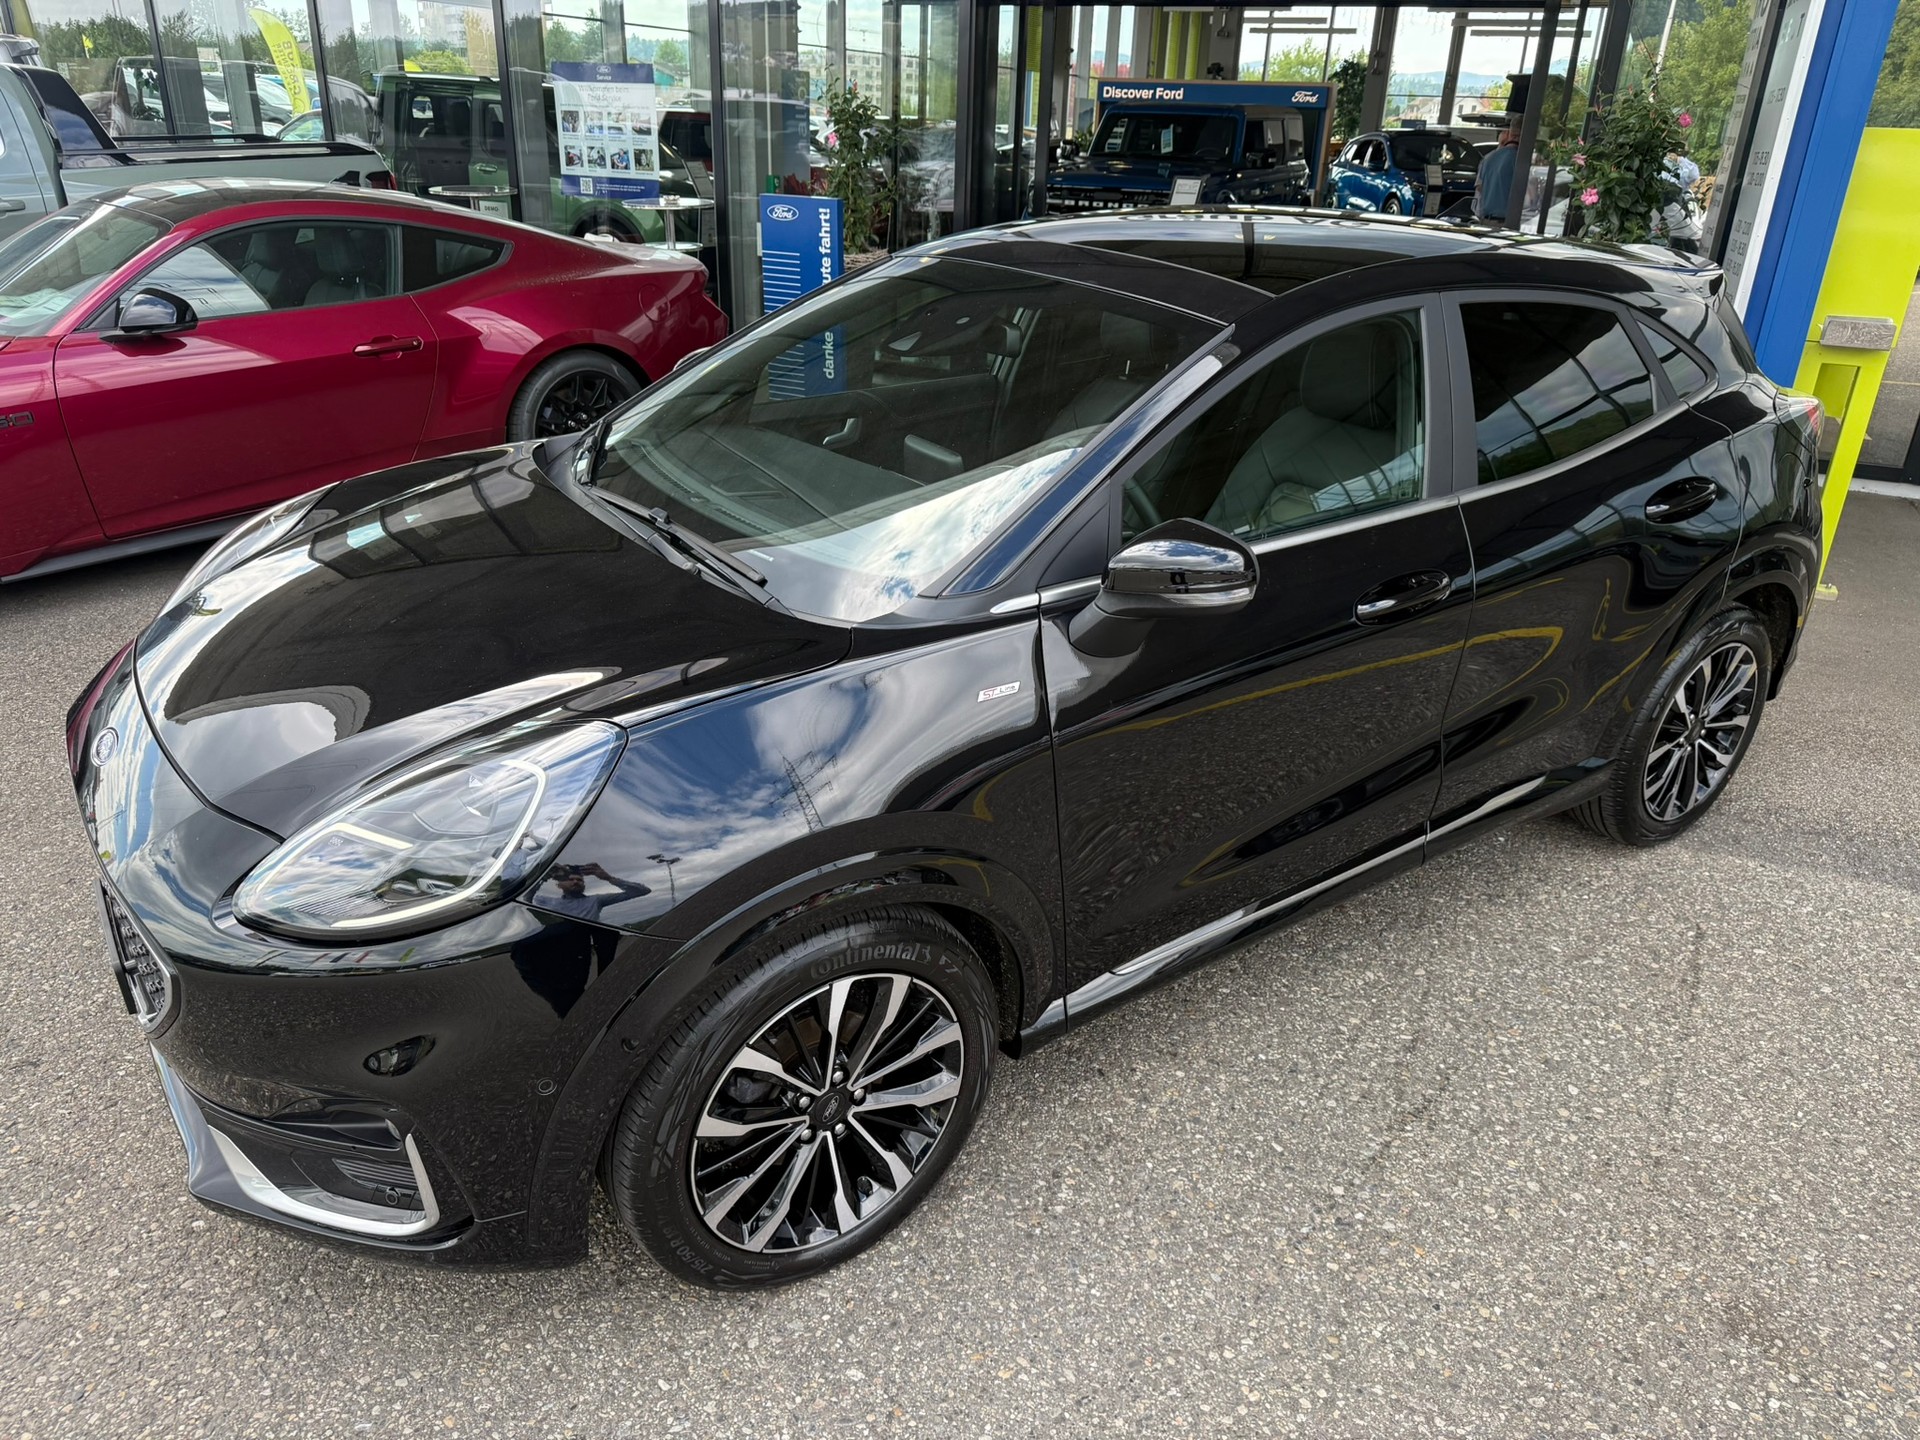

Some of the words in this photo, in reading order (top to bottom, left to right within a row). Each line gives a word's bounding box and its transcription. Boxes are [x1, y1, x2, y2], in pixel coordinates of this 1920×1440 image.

[1103, 86, 1154, 99] Discover
[1155, 87, 1184, 100] Ford
[1291, 90, 1319, 103] Ford
[772, 205, 794, 219] Ford
[819, 208, 831, 255] fahrt!
[820, 256, 832, 286] ute
[823, 331, 834, 379] danke
[810, 942, 921, 979] Continental
